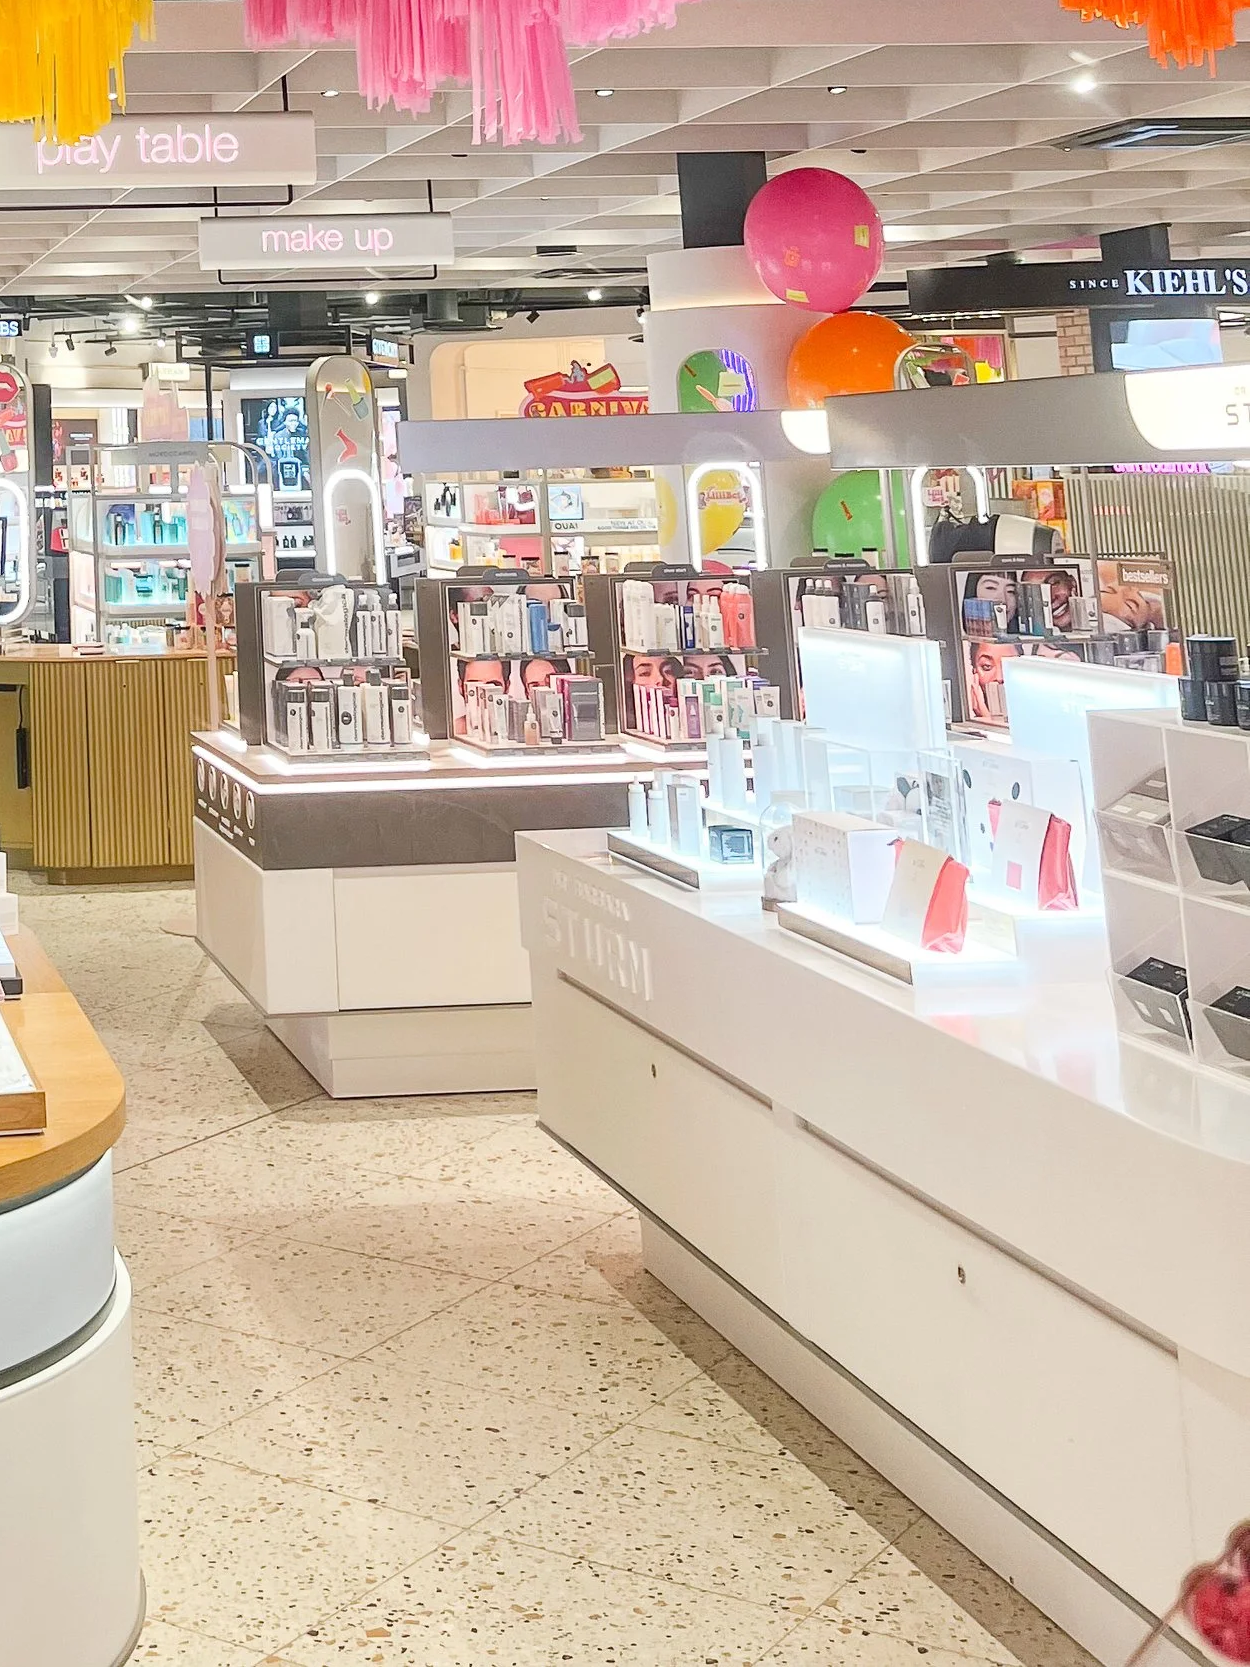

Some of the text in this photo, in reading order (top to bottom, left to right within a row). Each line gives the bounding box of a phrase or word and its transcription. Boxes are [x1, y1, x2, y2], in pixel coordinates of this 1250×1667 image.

[137, 124, 239, 165] table
[261, 222, 393, 257] make up
[1069, 268, 1249, 296] SINCE KIEHL'S
[1122, 568, 1169, 586] bestsellers
